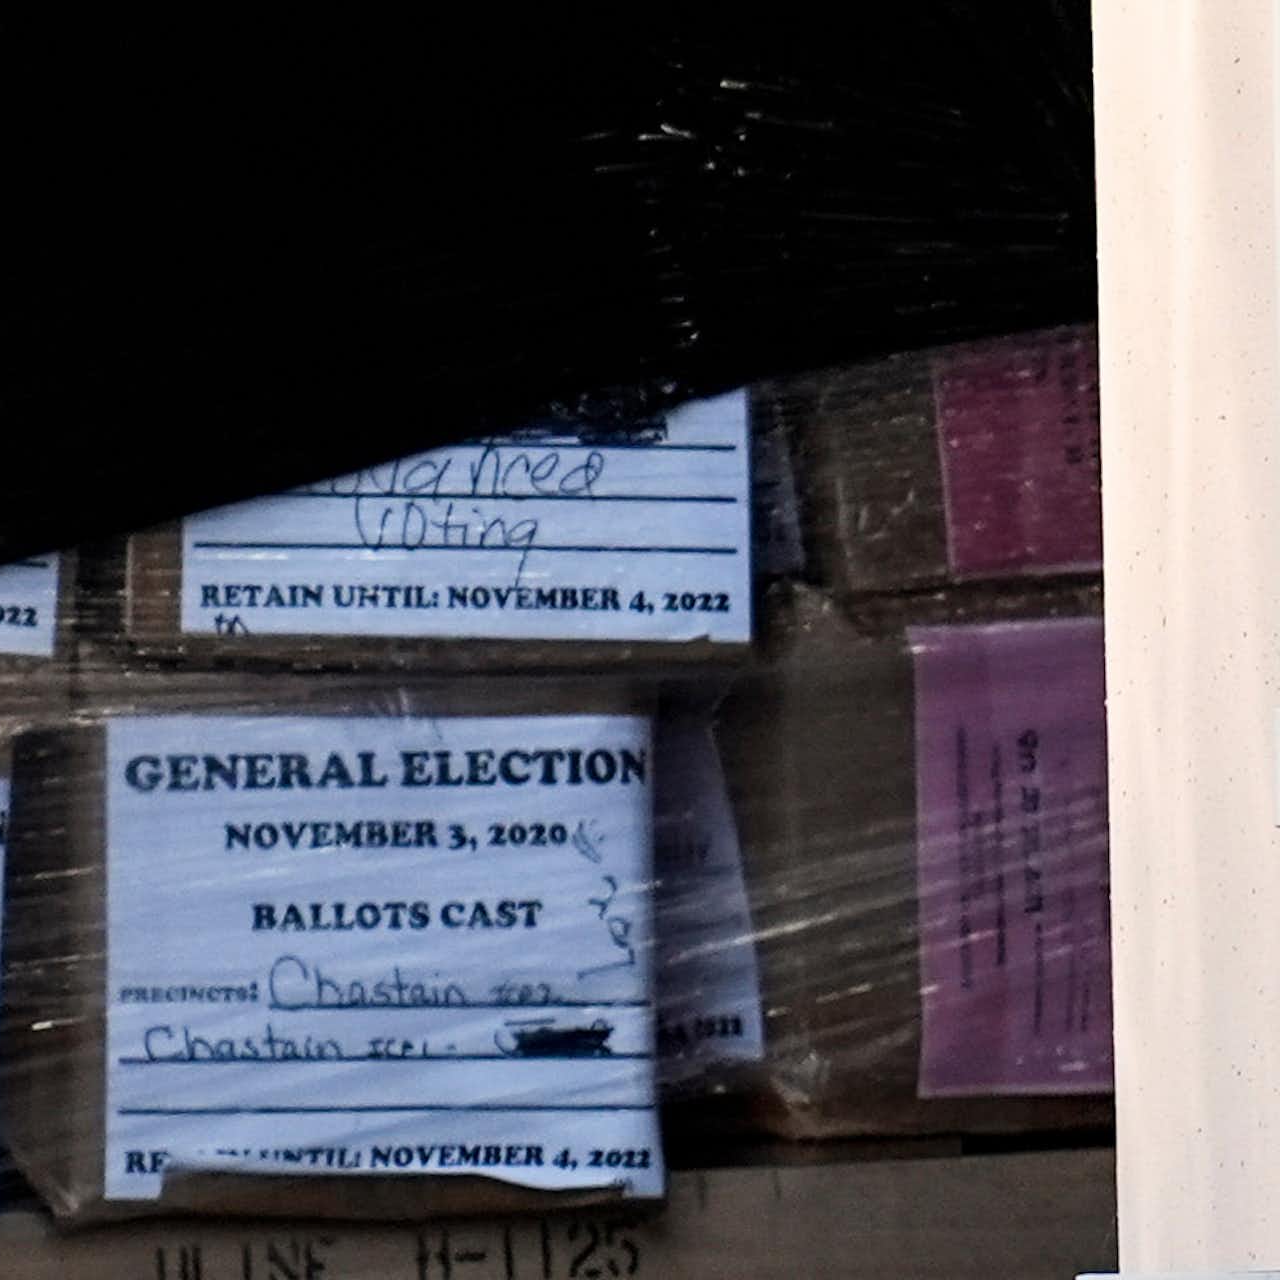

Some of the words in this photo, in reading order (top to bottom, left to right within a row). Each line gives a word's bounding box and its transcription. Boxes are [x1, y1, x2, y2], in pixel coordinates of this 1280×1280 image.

[200, 584, 319, 608] RETAIN
[333, 585, 439, 608] UNTIL:
[447, 586, 620, 612] NOVEMBER
[628, 592, 654, 614] 4,
[664, 592, 730, 612] 2022
[125, 752, 388, 793] GENERAL
[401, 749, 648, 788] ELECTION
[224, 821, 438, 851] NOVEMBER
[448, 824, 478, 852] 3,
[487, 823, 568, 847] 2020
[252, 902, 430, 931] BALLOTS
[440, 900, 544, 929] CAST
[121, 982, 259, 1004] PRECINCTS:
[371, 1144, 545, 1169] NOVEMBER
[552, 1148, 578, 1170] 4,
[586, 1148, 651, 1168] 2022
